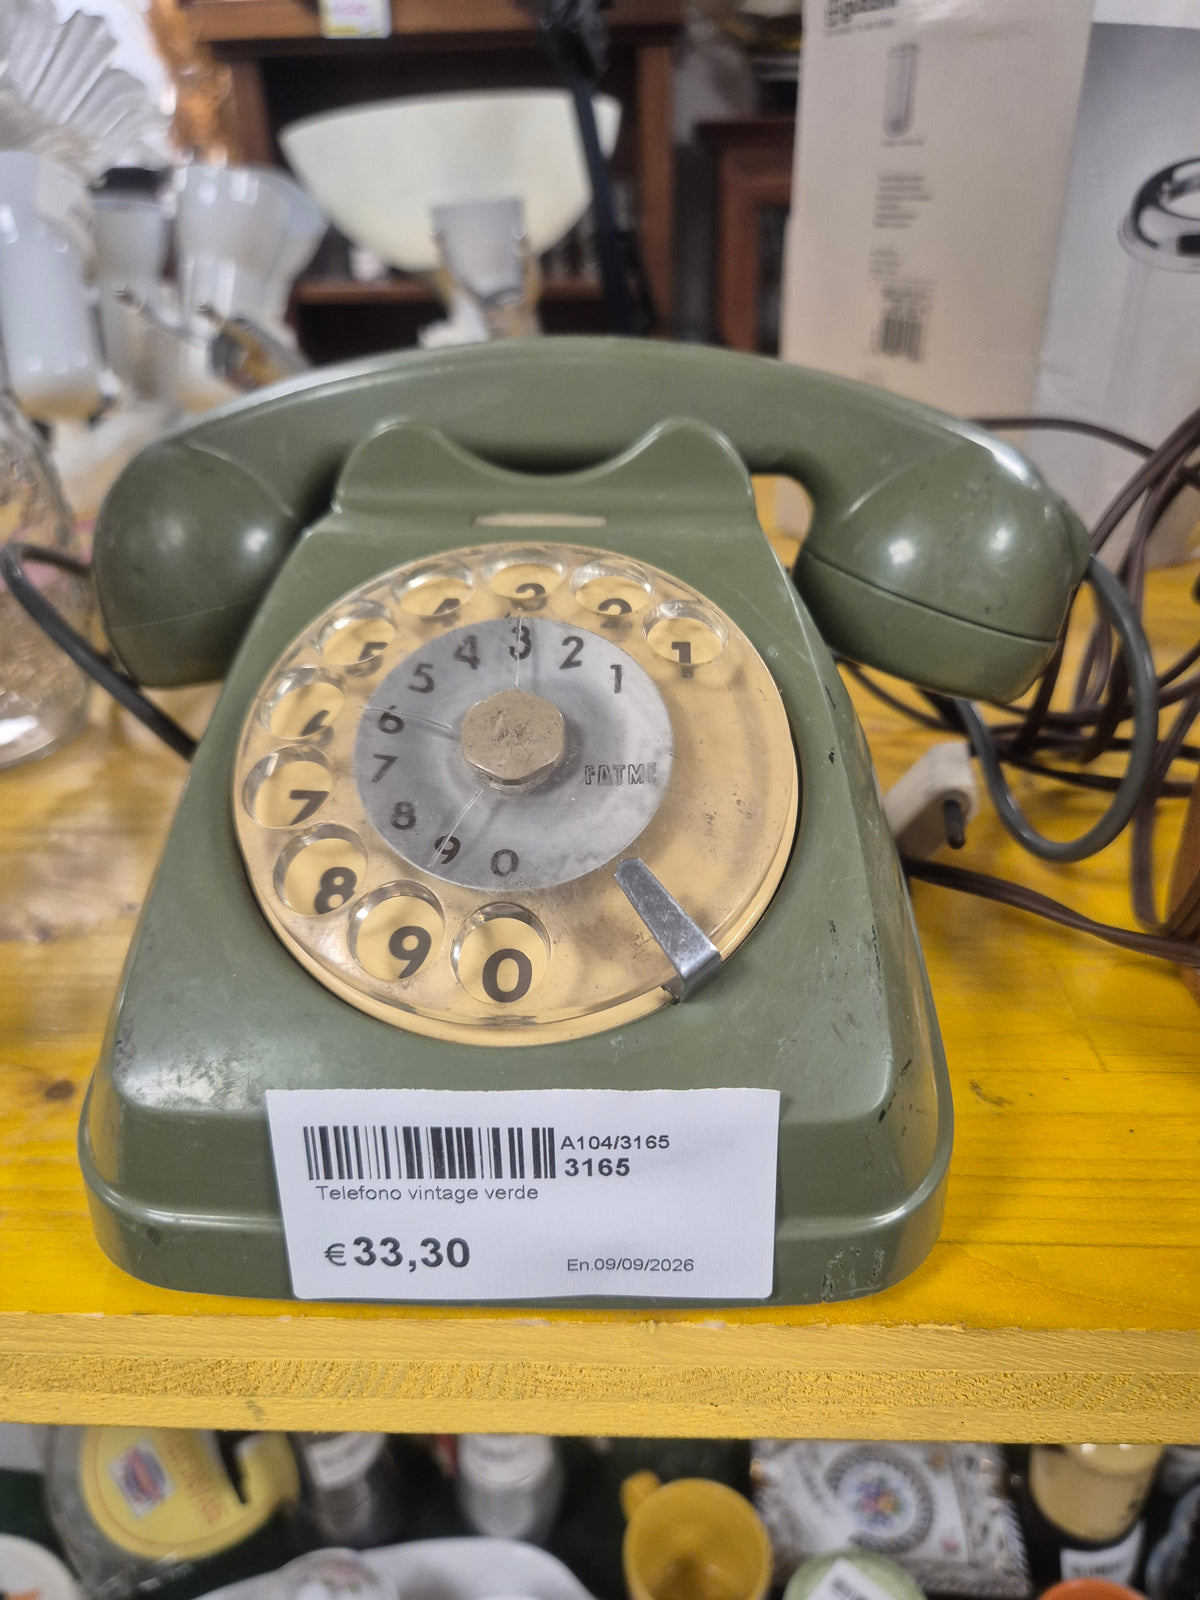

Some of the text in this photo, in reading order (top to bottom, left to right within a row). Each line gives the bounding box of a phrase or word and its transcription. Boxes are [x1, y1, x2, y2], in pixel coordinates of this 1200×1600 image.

[453, 635, 481, 670] 4
[509, 625, 532, 660] 3
[559, 636, 584, 670] 2
[408, 663, 435, 694] 5
[610, 664, 623, 694] 1
[377, 705, 405, 735] 6
[372, 754, 399, 783] 7
[289, 789, 330, 826] 7
[390, 801, 417, 831] 8
[434, 835, 461, 865] 9
[490, 848, 519, 878] 0
[314, 866, 358, 915] 8
[388, 925, 432, 979] 9
[482, 948, 533, 1002] 0
[560, 1135, 670, 1150] A104/3165
[564, 1157, 630, 1177] 3165
[316, 1184, 539, 1204] Telefono vintage verde
[567, 1258, 695, 1272] En.09/09/2026
